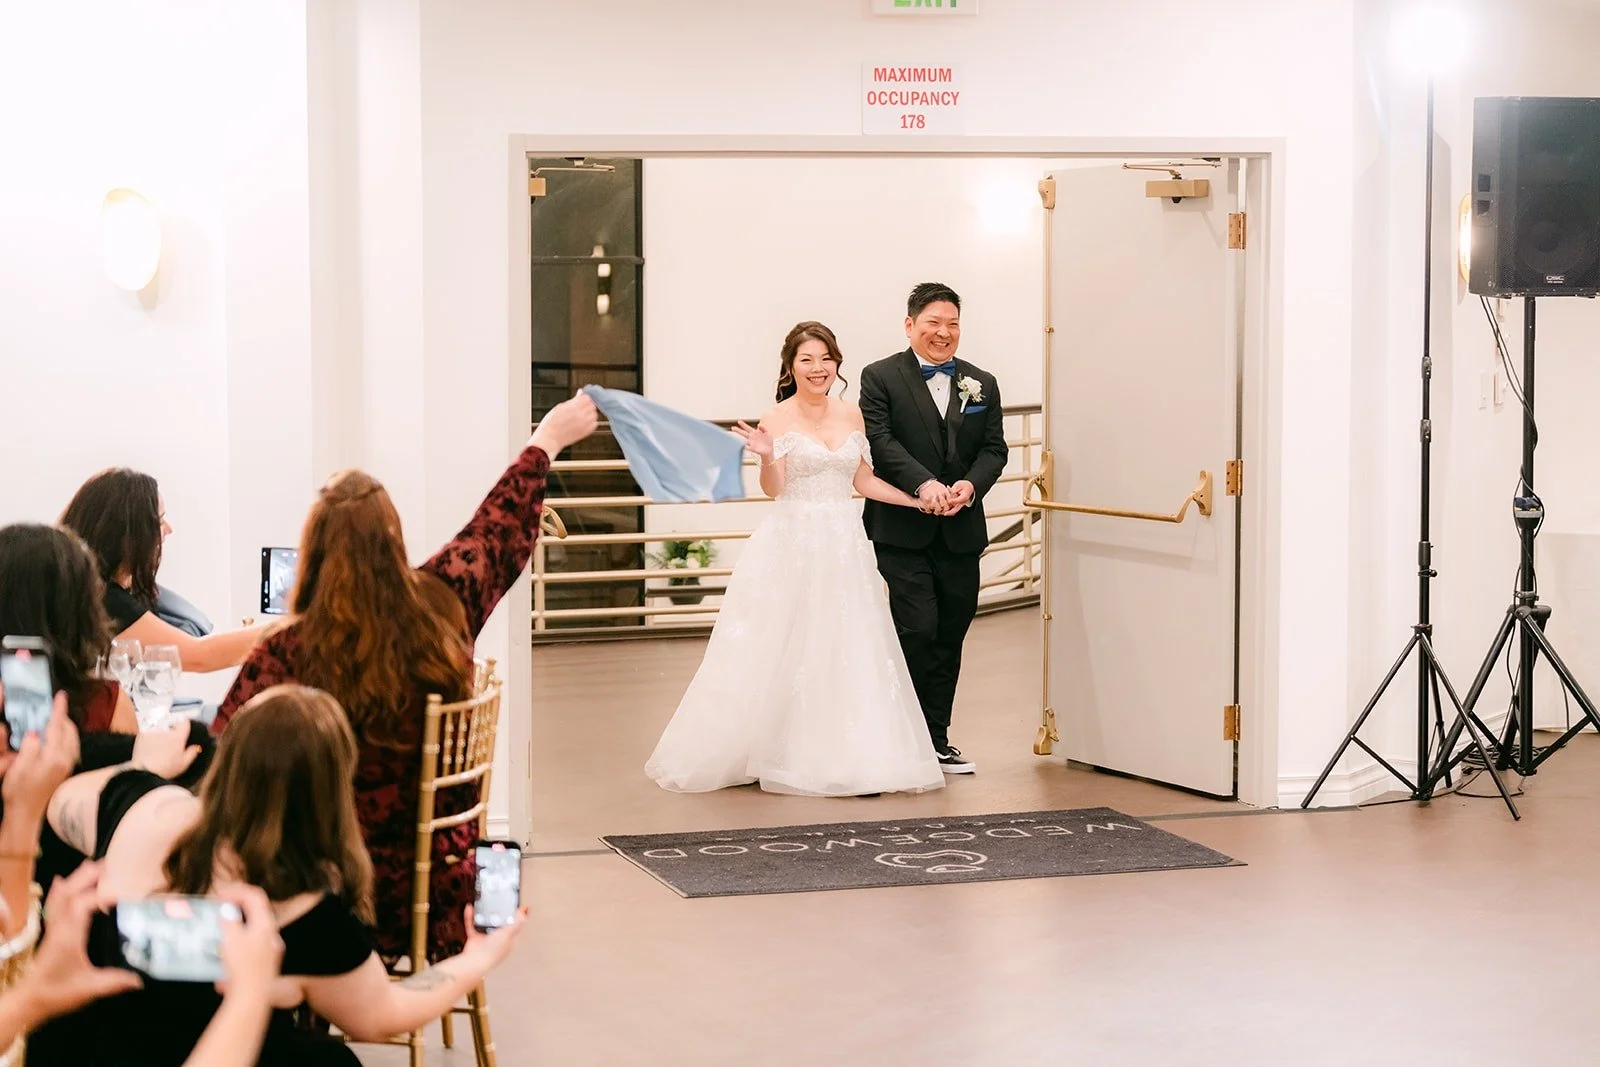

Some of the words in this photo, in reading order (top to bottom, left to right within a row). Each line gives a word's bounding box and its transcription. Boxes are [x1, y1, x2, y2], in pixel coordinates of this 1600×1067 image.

[873, 67, 952, 83] MAXIMUM
[867, 91, 960, 106] OCCUPANCY
[900, 114, 926, 129] 178
[643, 822, 1142, 858] WEDGEWOOD
